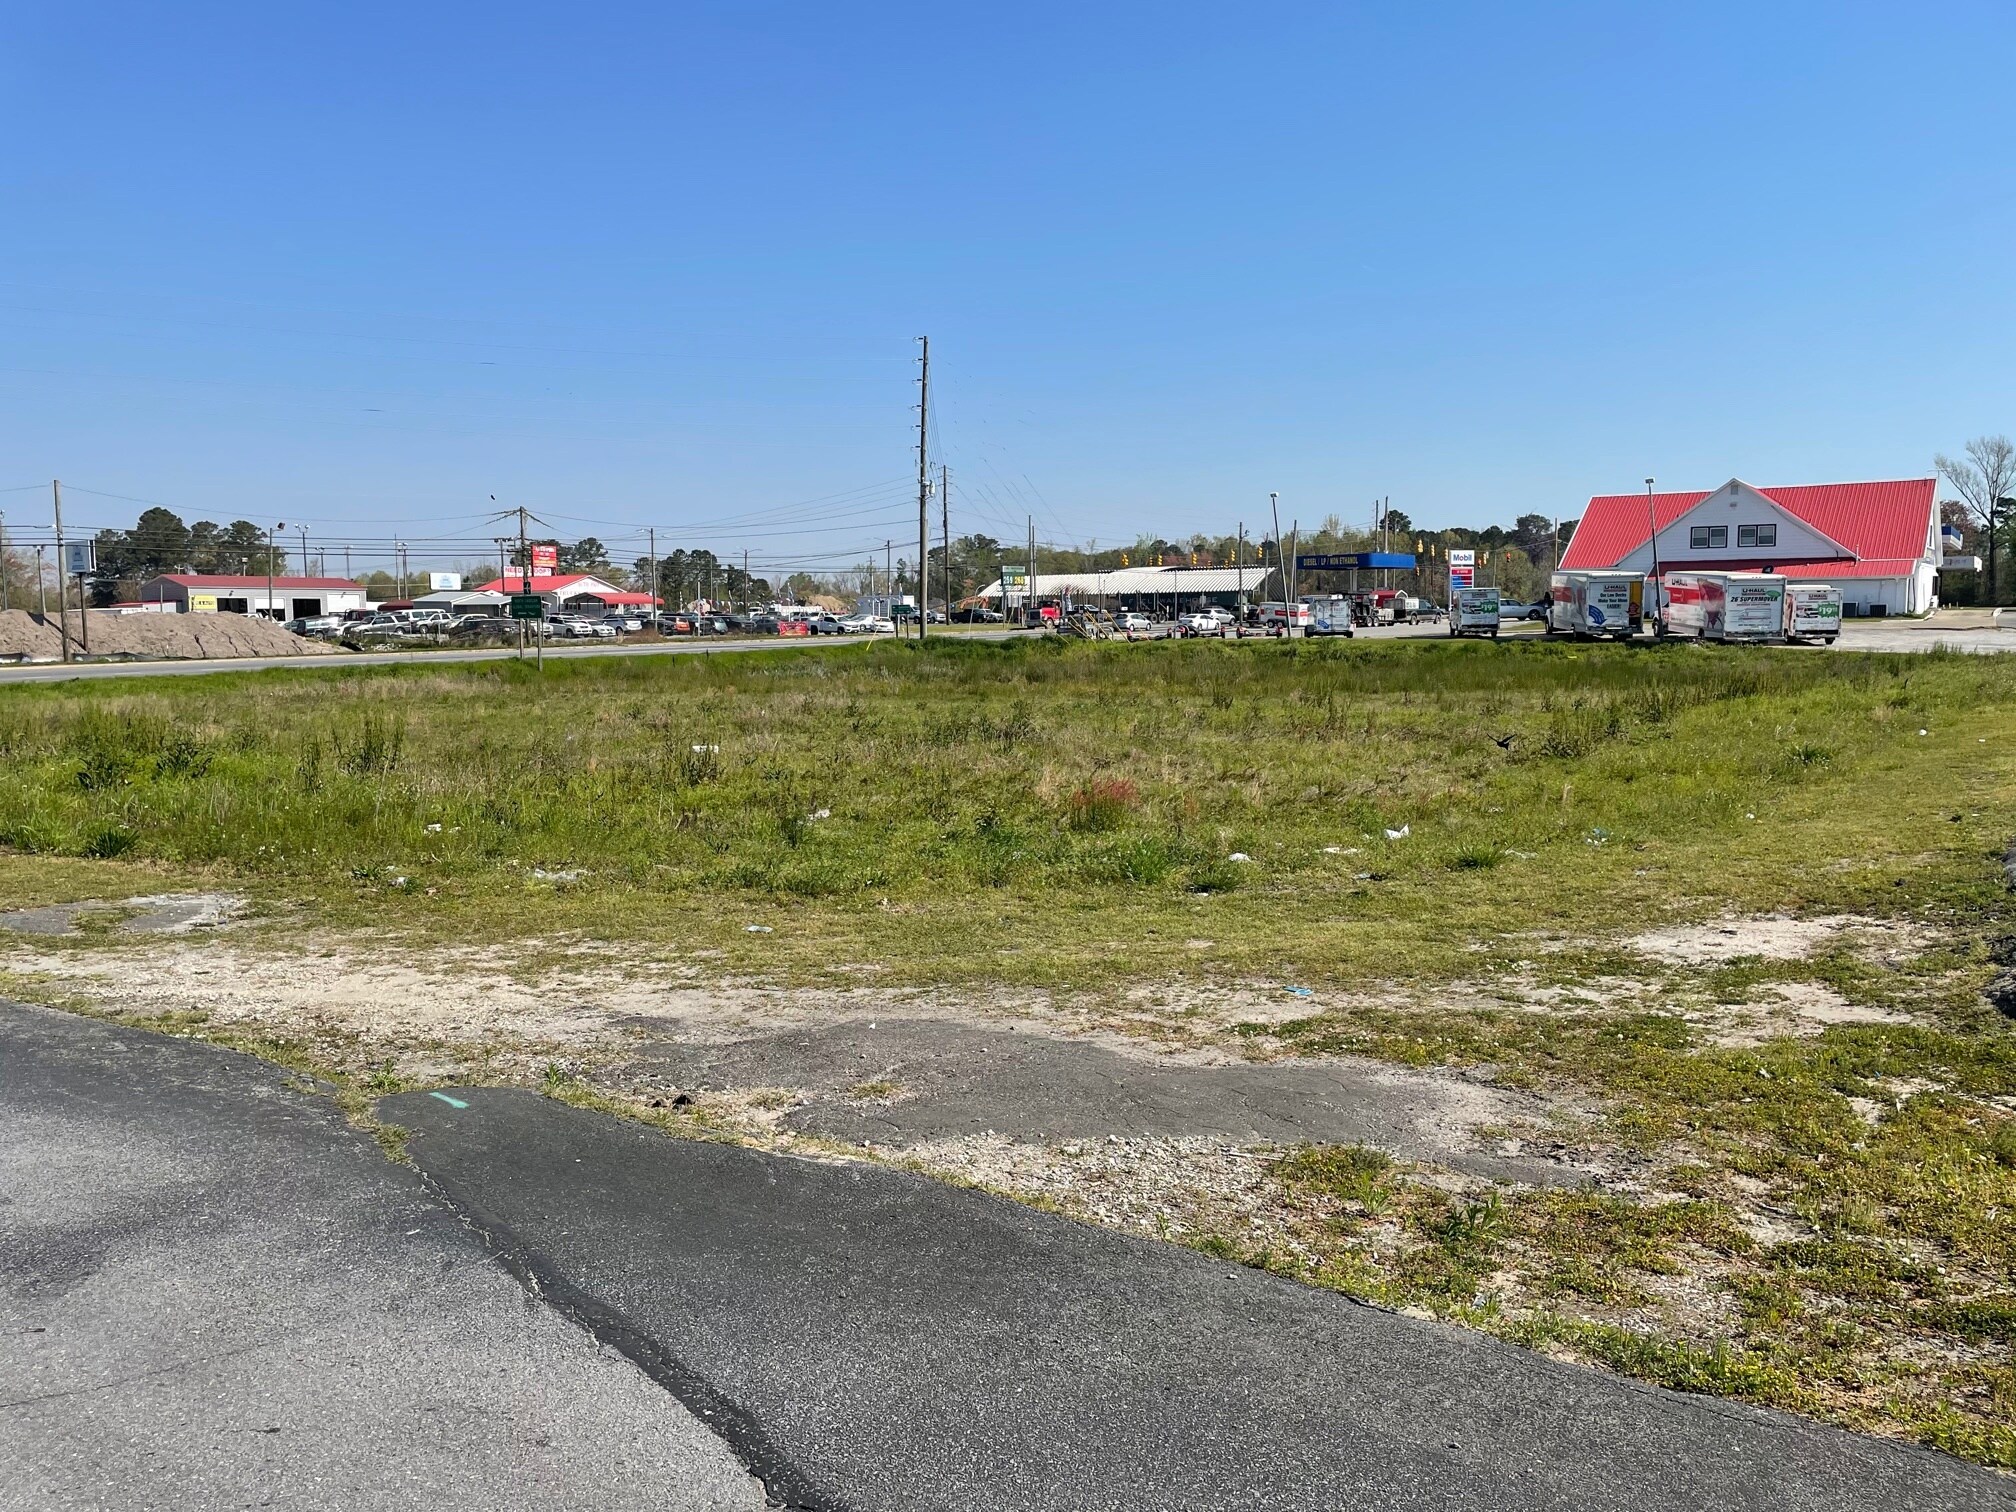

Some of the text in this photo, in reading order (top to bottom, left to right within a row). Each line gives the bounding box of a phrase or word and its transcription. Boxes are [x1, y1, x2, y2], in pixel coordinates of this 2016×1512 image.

[1303, 558, 1317, 566] DIESEL
[1330, 557, 1338, 565] NON
[1339, 556, 1358, 565] ETHANOL
[1160, 596, 1219, 604] WAEHOSE
